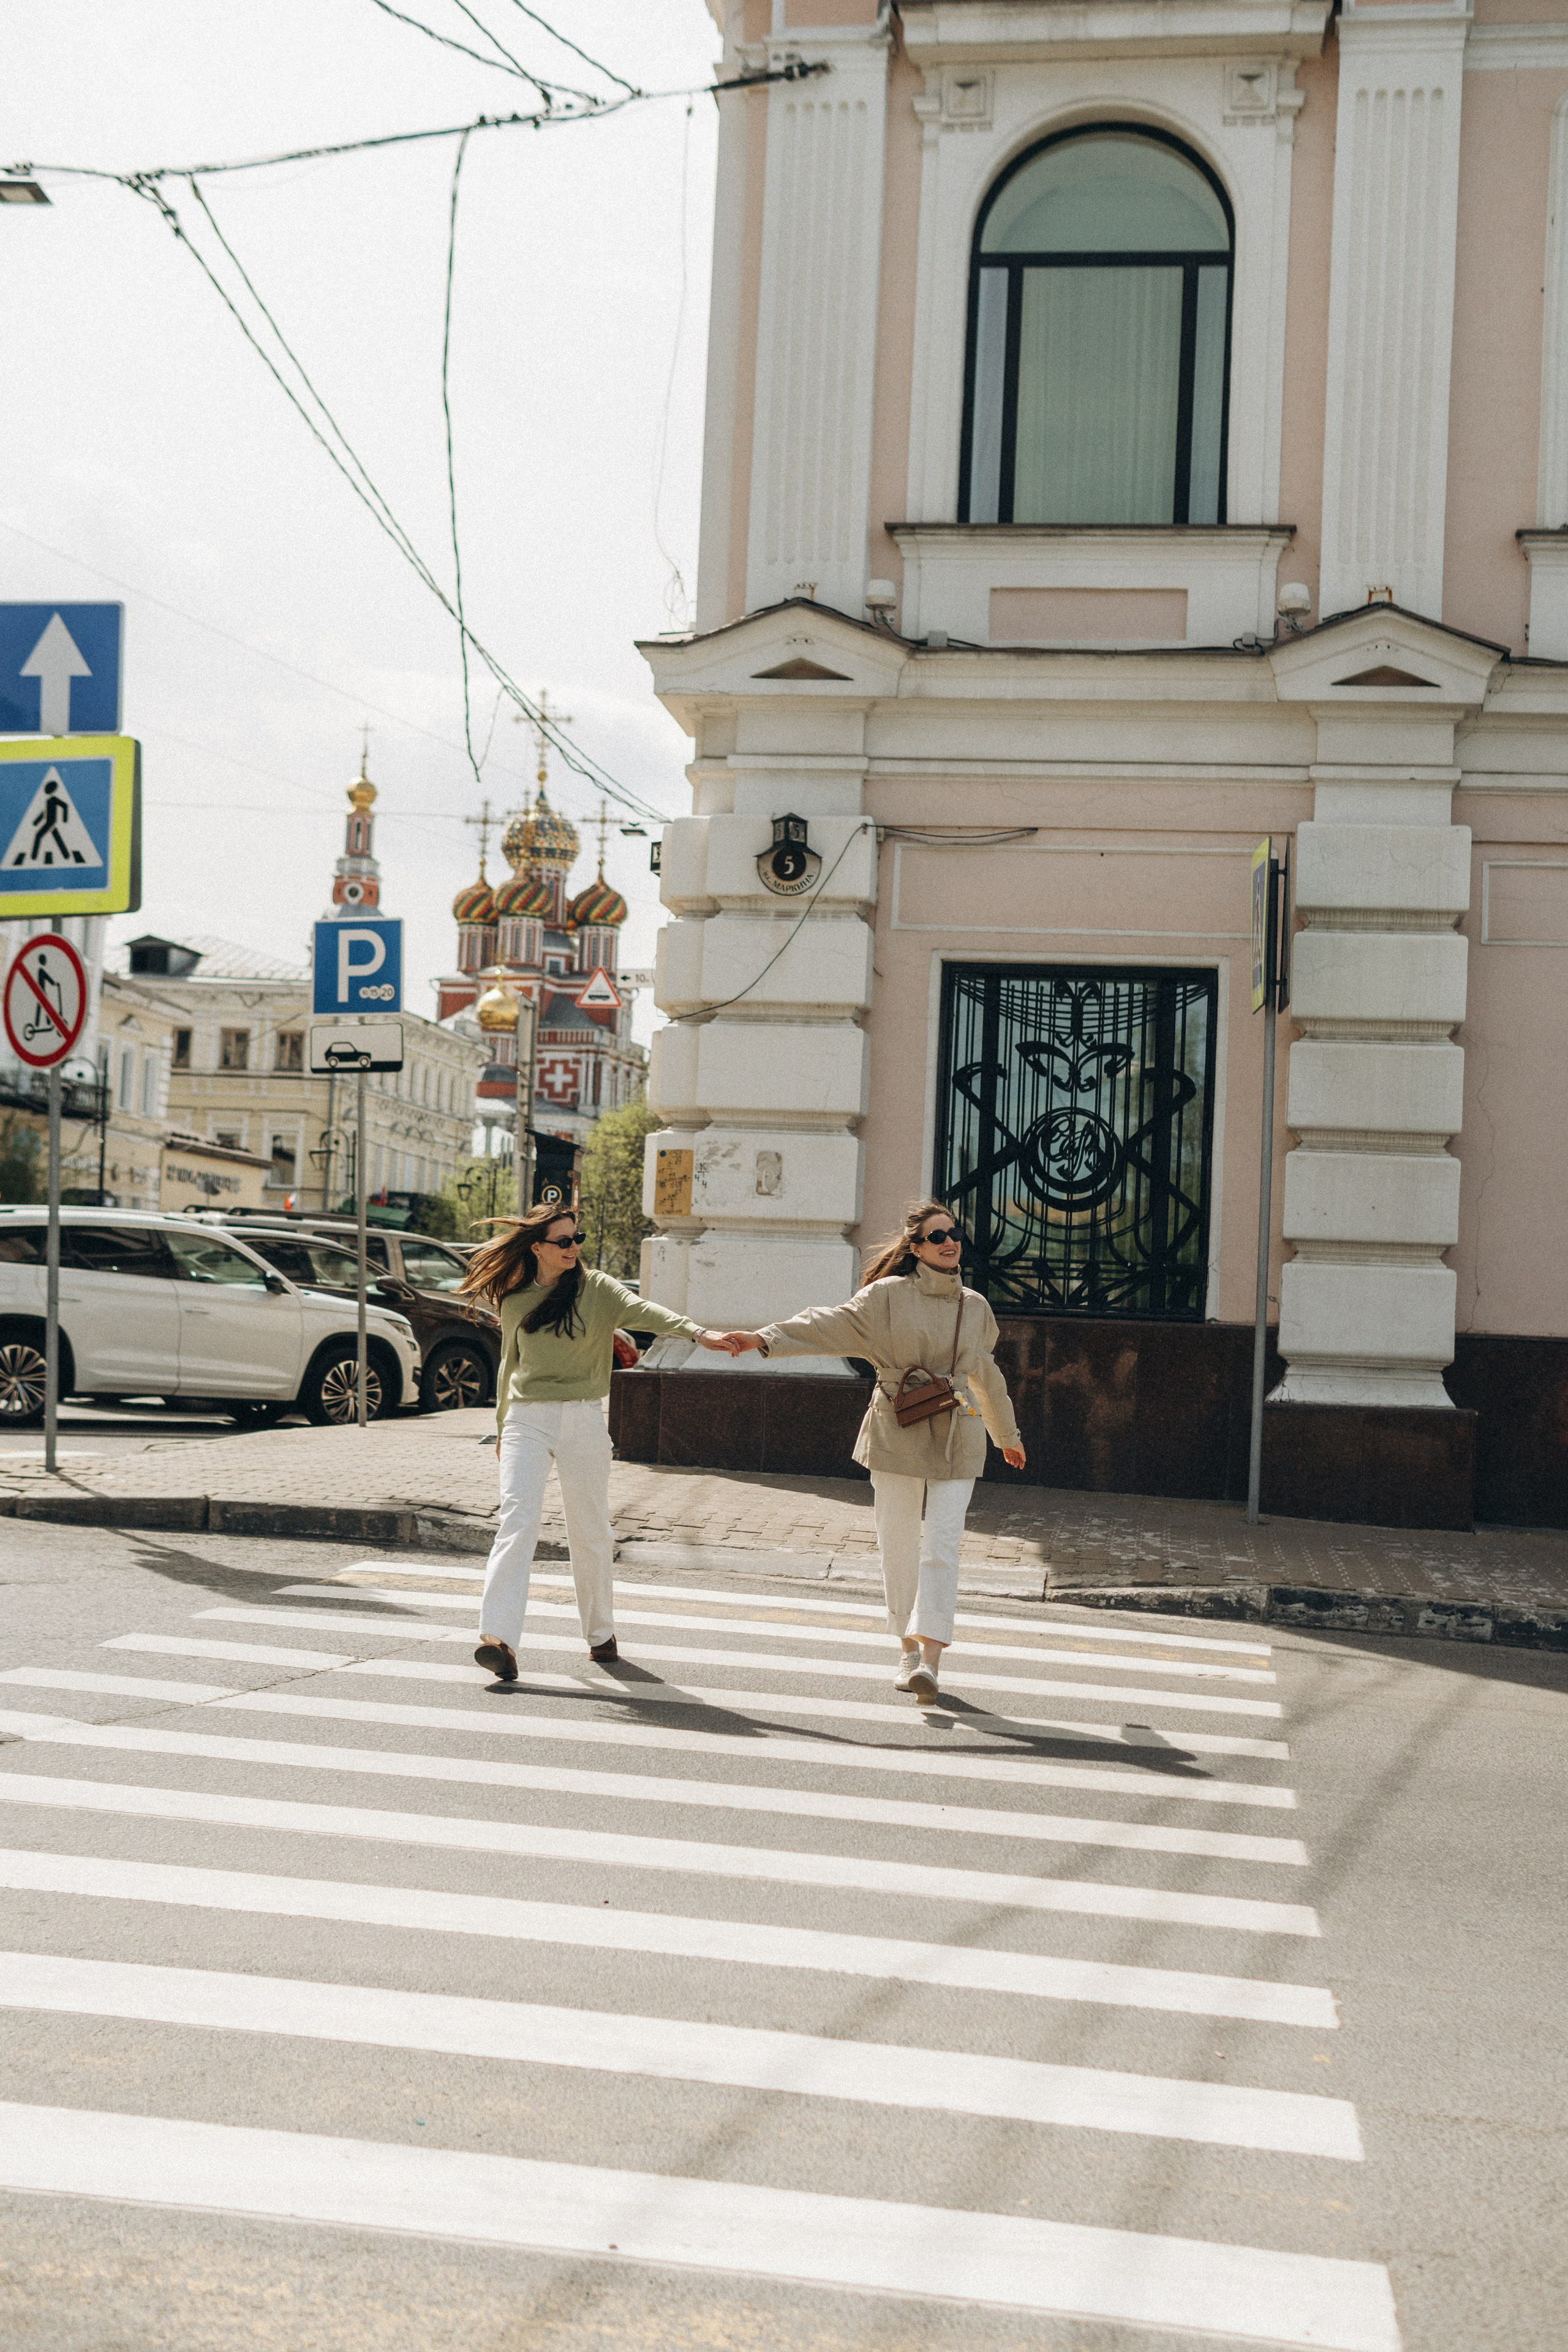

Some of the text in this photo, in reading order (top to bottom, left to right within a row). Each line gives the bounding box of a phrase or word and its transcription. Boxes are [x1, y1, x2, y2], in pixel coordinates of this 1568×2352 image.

[784, 855, 794, 875] 5
[772, 875, 813, 891] МАРКИНА
[338, 929, 386, 1002] P
[382, 988, 393, 997] 20
[548, 1190, 557, 1202] P
